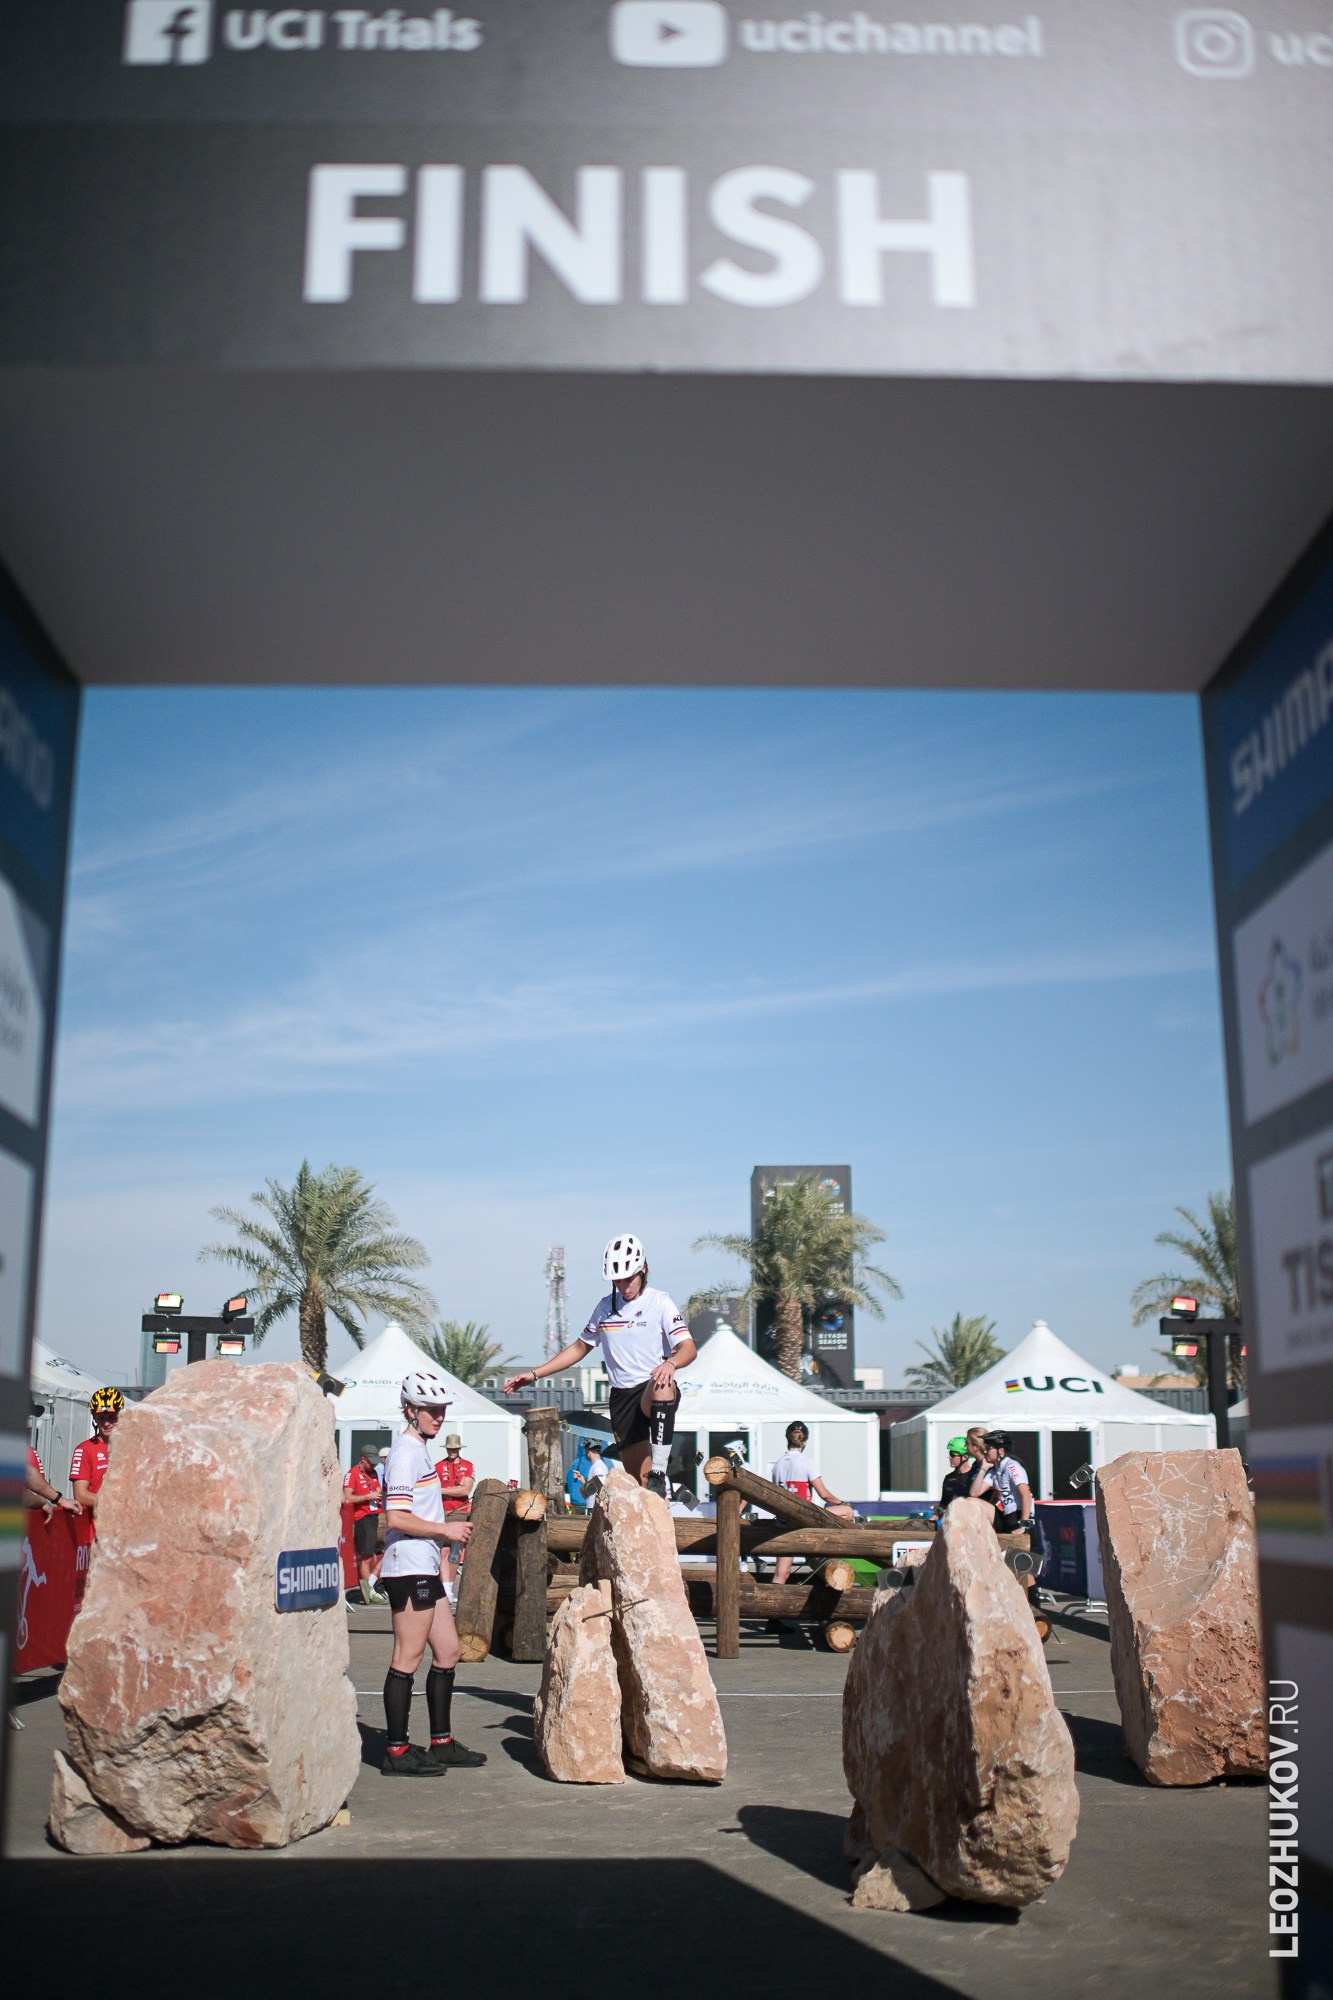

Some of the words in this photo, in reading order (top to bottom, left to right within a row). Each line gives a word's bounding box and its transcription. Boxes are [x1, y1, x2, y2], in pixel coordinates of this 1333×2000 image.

[224, 10, 324, 50] UCI
[334, 8, 482, 52] Trials
[741, 14, 1045, 58] ucichannel
[303, 163, 977, 308] FINISH
[1023, 1375, 1105, 1394] UCI
[279, 1562, 339, 1595] SHIMANO
